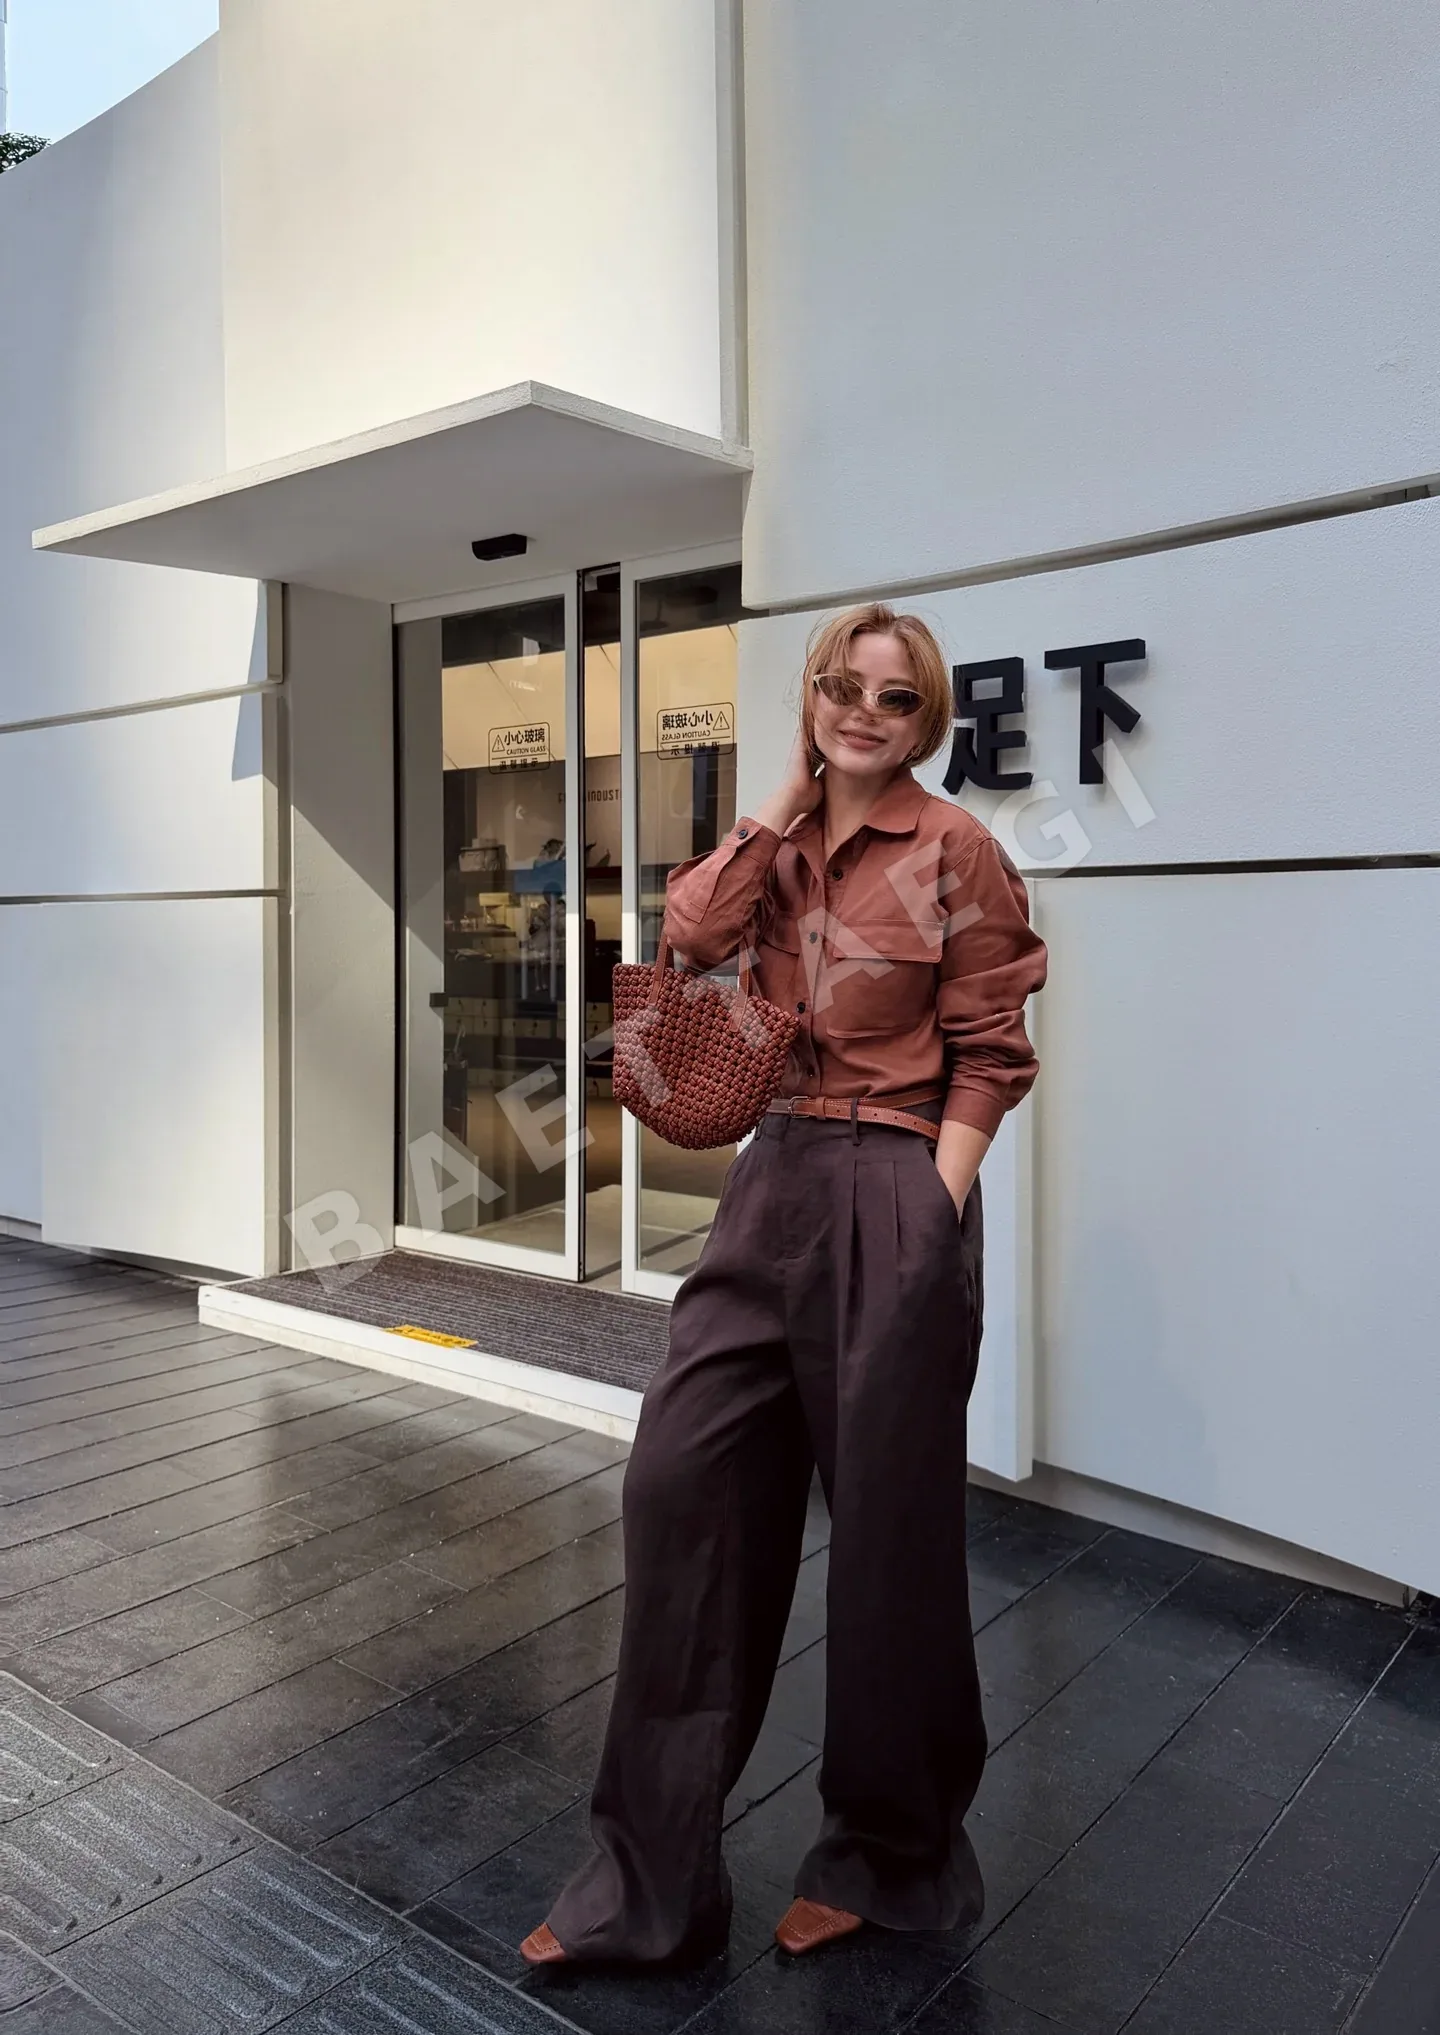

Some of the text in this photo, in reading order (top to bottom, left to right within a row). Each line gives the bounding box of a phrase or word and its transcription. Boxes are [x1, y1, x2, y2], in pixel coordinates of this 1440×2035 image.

[942, 638, 1146, 795] 足下
[504, 727, 545, 746] 小心玻璃
[506, 745, 546, 756] CAUTION GLASS
